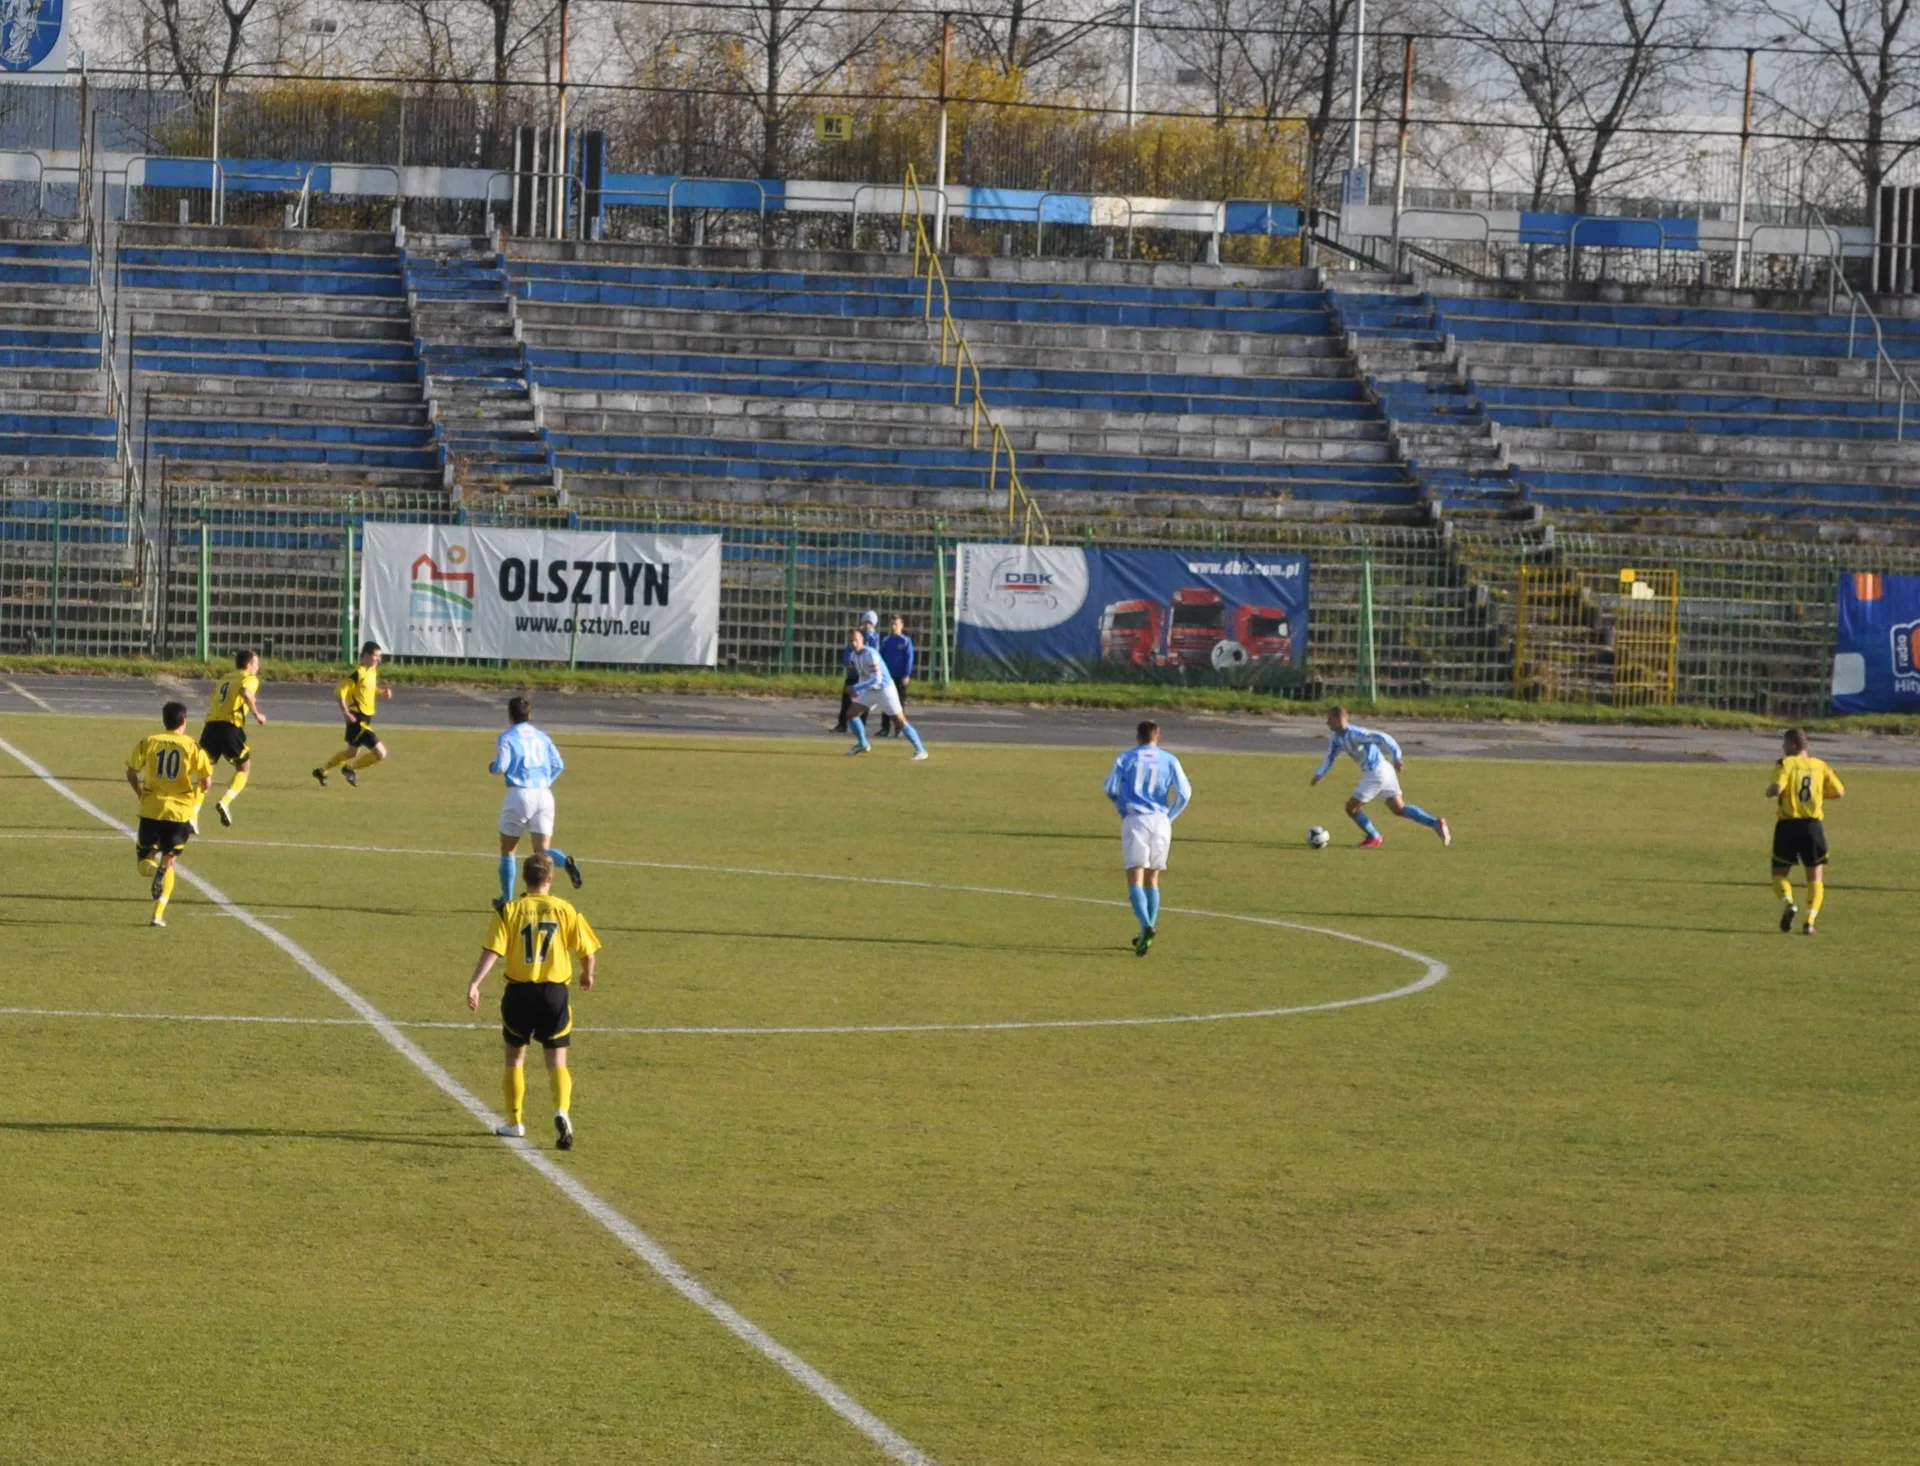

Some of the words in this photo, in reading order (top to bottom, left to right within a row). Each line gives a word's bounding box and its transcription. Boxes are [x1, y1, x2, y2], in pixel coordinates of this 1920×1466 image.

[500, 557, 670, 606] OLSZTYN
[1005, 572, 1054, 585] DBK
[1188, 560, 1300, 579] www.dbk.com.pl
[515, 616, 650, 637] www.osztyn.eu
[155, 748, 181, 780] 10
[519, 738, 545, 768] 10
[1798, 775, 1812, 803] 8
[520, 922, 558, 964] 17
